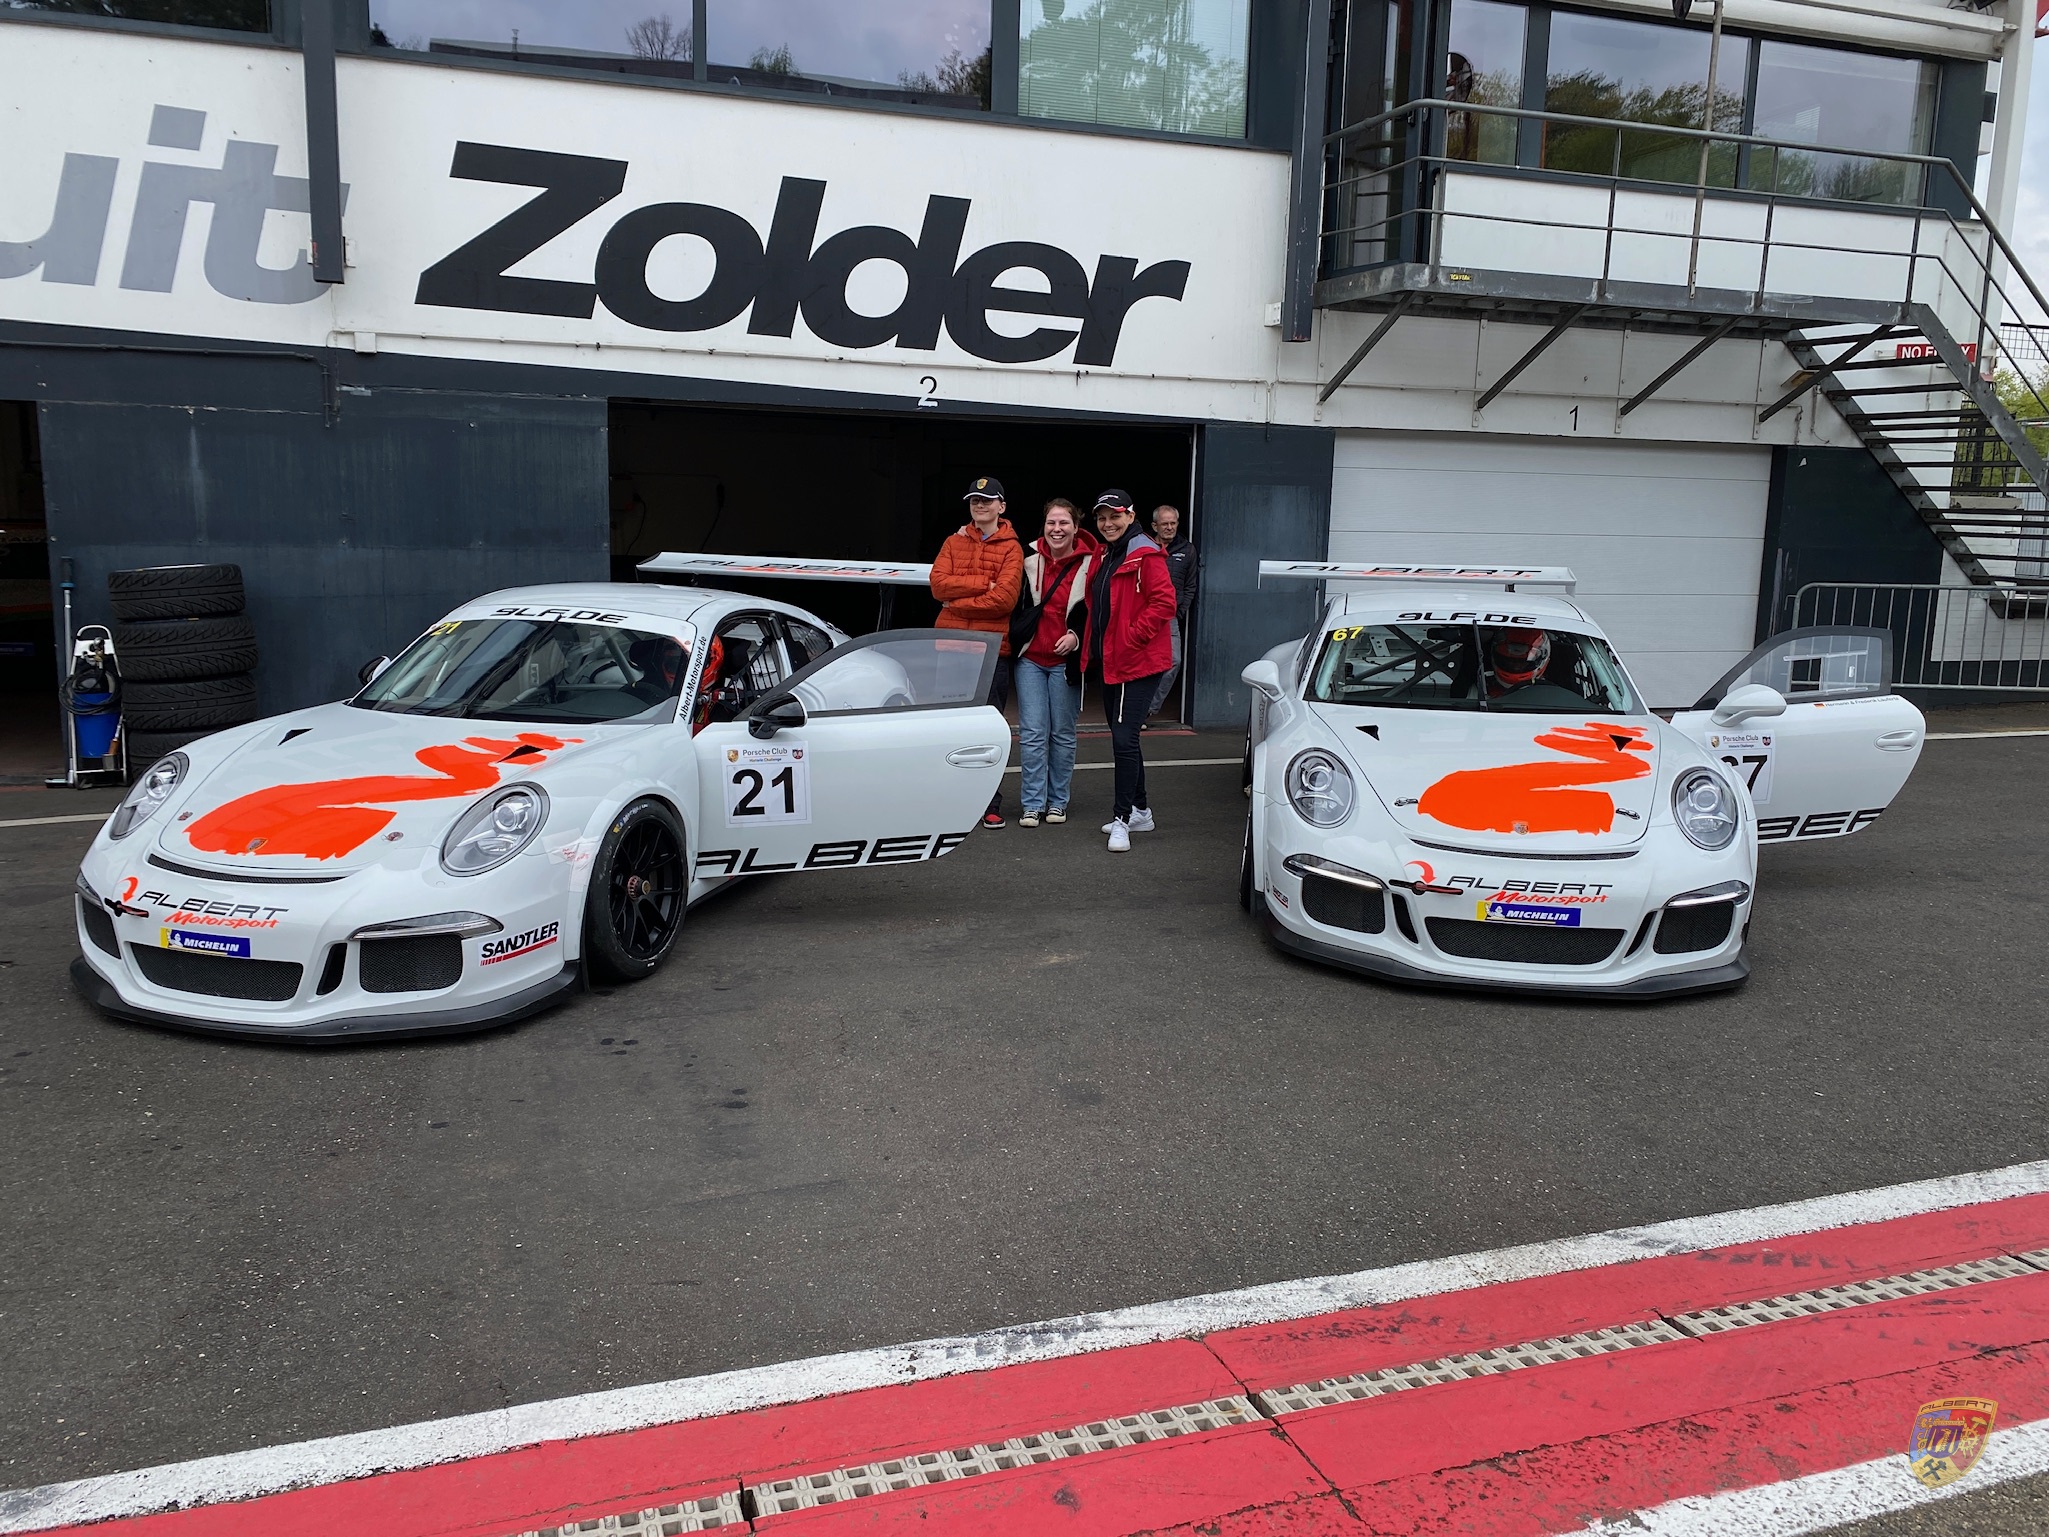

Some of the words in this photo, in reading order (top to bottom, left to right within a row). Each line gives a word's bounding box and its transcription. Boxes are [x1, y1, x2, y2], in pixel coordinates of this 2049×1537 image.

[414, 141, 1191, 367] Zolder
[1901, 346, 1921, 359] NO
[917, 375, 939, 407] 2
[1569, 405, 1579, 431] 1
[1287, 565, 1542, 576] ALBERT
[430, 621, 463, 637] 21
[1332, 626, 1364, 642] 67
[679, 636, 708, 721] Albert-Motorsport.de
[771, 747, 788, 755] Club
[1721, 754, 1768, 795] 7
[732, 766, 795, 817] 21
[1447, 875, 1614, 895] ALBERT
[138, 890, 290, 920] ALBERT
[1485, 890, 1609, 906] Motorsport
[164, 911, 280, 930] Motorsport
[1506, 909, 1570, 921] MICHELIN
[184, 937, 240, 952] MICHELIN
[481, 921, 559, 958] SANDTLER
